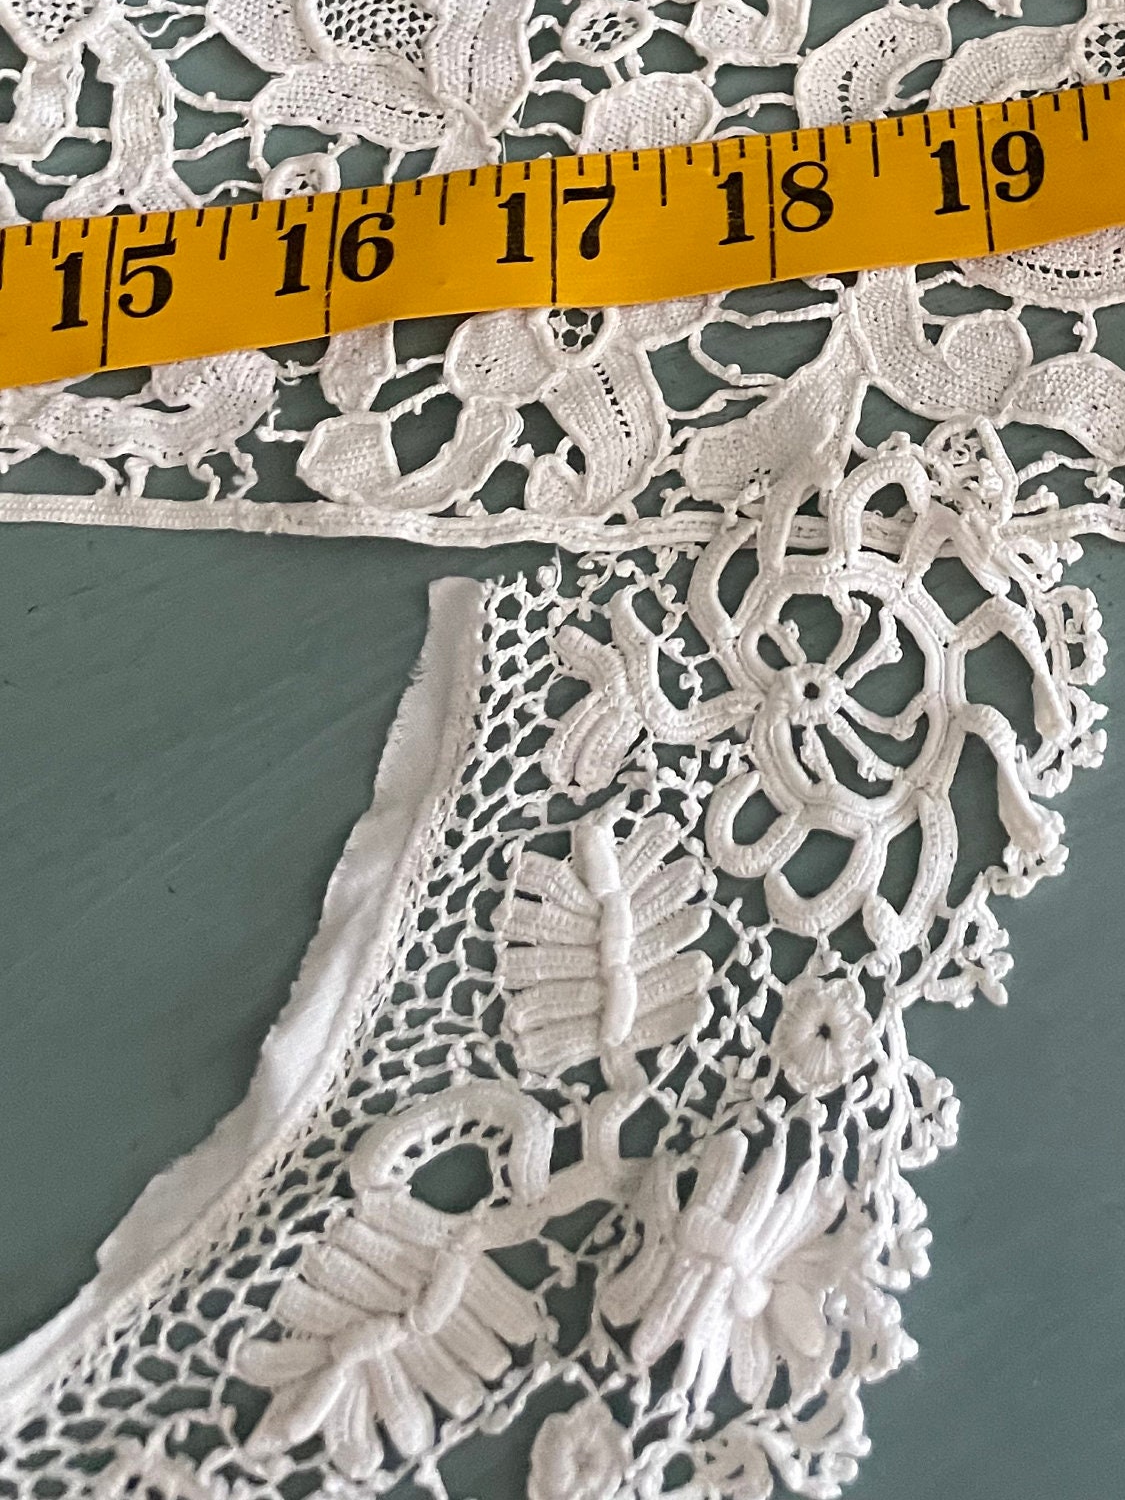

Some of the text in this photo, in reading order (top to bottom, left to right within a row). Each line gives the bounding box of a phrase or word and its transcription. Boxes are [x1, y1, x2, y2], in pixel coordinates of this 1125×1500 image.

[52, 239, 176, 332] 15
[275, 213, 395, 297] 16
[496, 187, 616, 264] 17
[717, 160, 834, 246] 18
[929, 130, 1046, 216] 19
